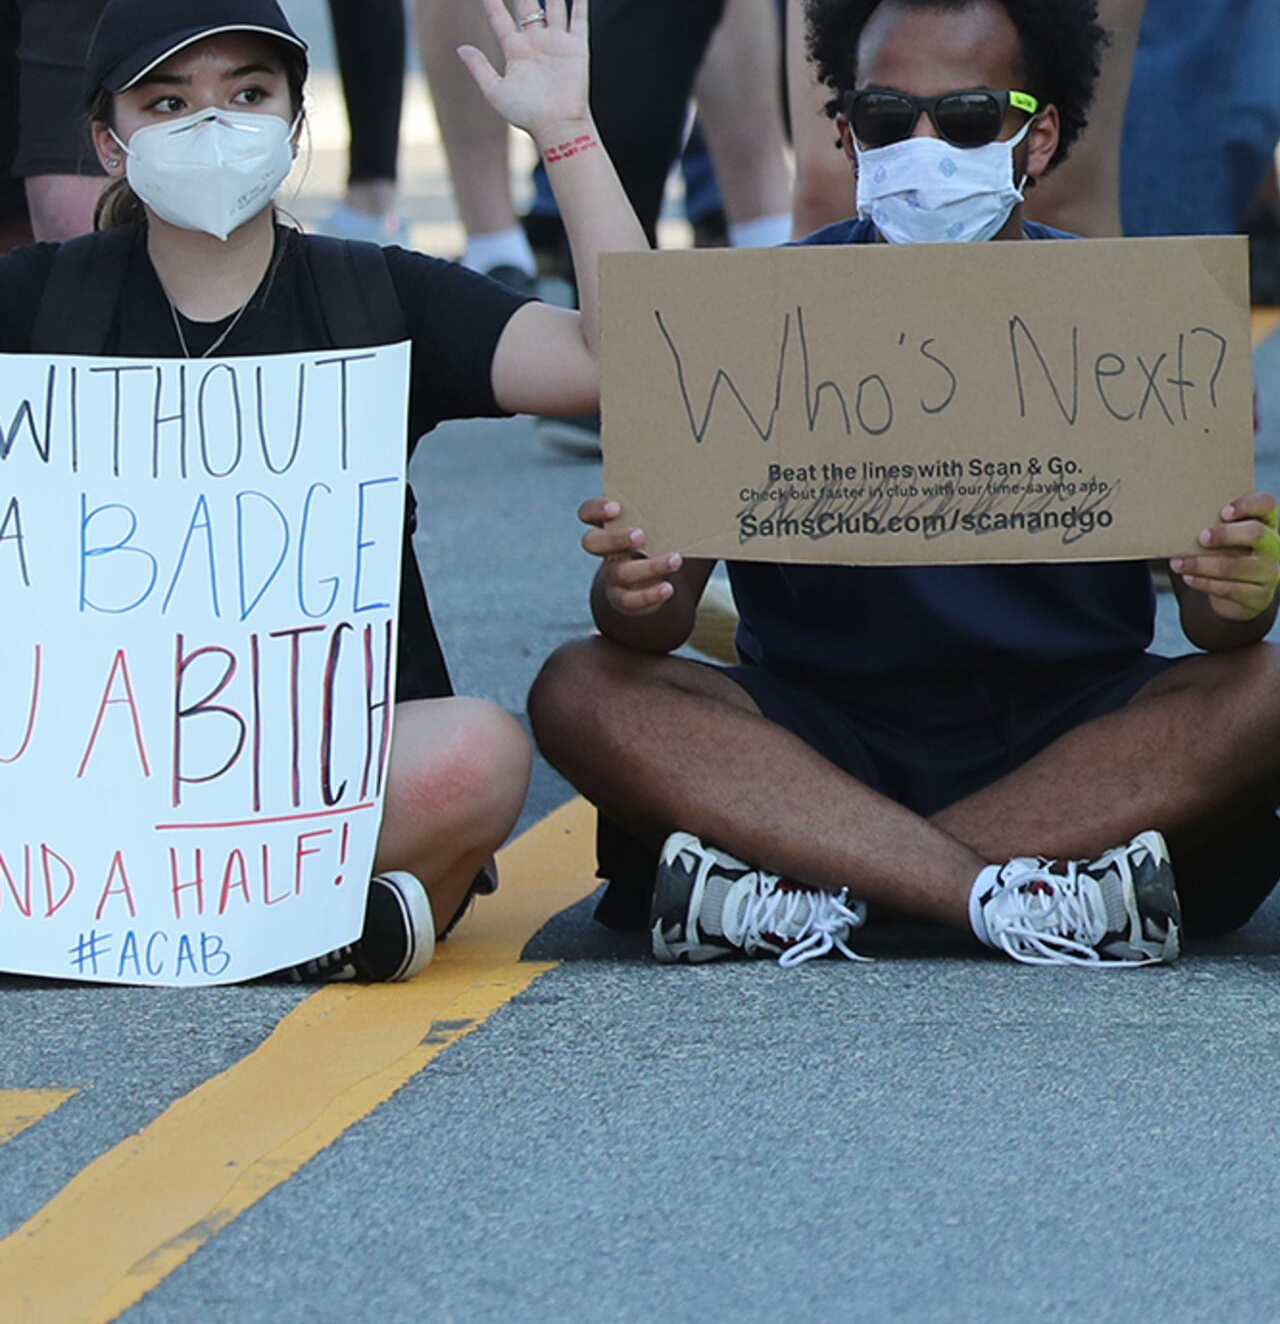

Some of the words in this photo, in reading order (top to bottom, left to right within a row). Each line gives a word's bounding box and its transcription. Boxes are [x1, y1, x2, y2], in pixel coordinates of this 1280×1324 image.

[655, 305, 957, 442] Who's
[1009, 314, 1228, 436] Next?
[768, 464, 817, 482] Beat
[822, 463, 857, 480] the
[862, 460, 914, 479] lines
[918, 459, 963, 478] with
[968, 457, 1021, 477] Scan
[1027, 457, 1042, 475] &
[1048, 456, 1083, 475] Go.
[820, 484, 865, 500] faster
[958, 483, 982, 497] our
[79, 477, 400, 621] BADGE
[739, 505, 1113, 537] SamsClub.com/scanandgo
[76, 648, 150, 778] A
[172, 618, 393, 814] BITCH
[96, 850, 135, 919] A
[169, 822, 349, 920] HALF!
[68, 930, 232, 977] #ACAB
